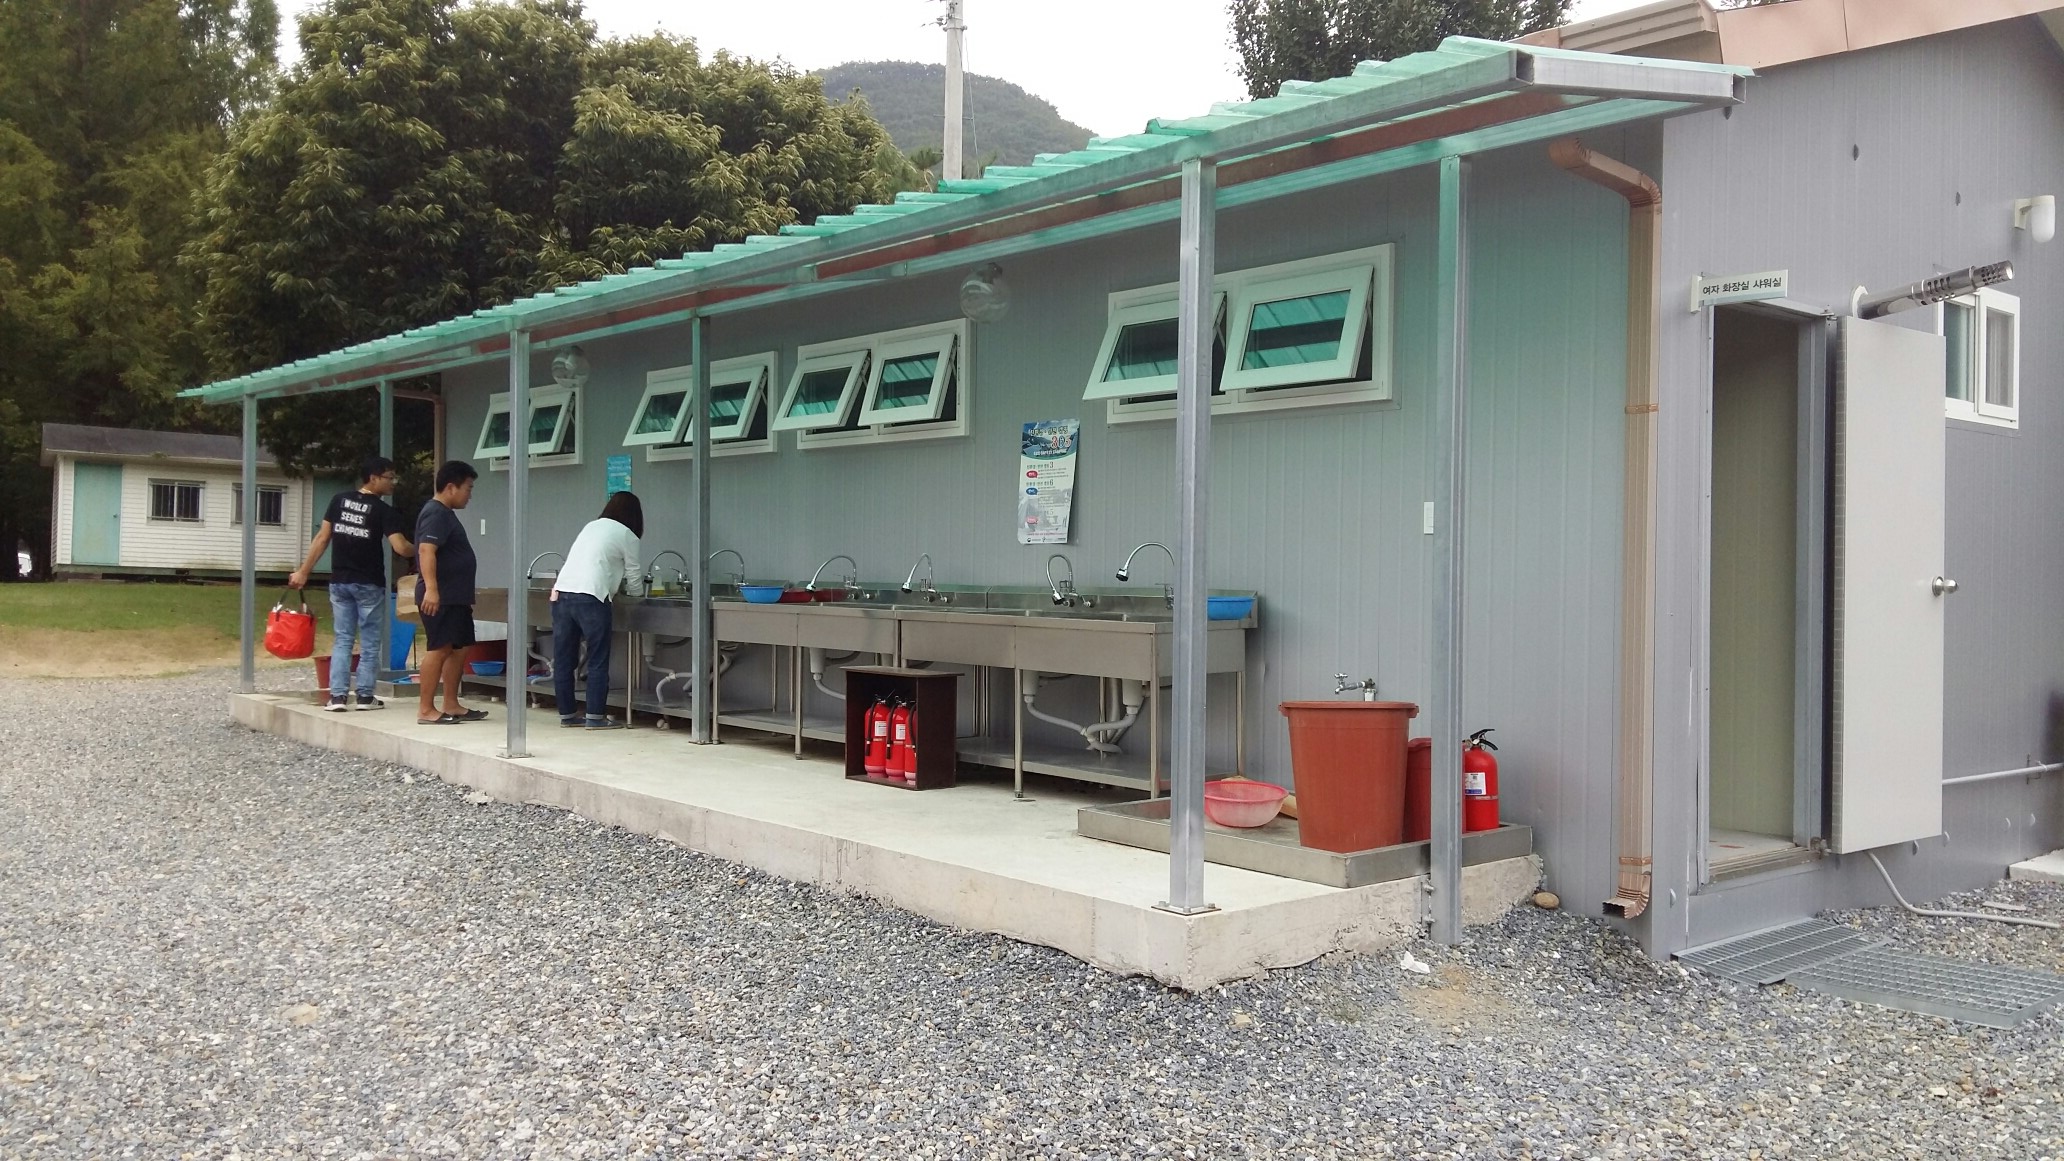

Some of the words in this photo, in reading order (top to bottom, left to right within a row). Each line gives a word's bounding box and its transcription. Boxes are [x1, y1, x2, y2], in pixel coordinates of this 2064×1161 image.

[1703, 285, 1719, 295] 여자
[1722, 281, 1750, 292] 화장실
[1753, 277, 1782, 289] 샤워실
[344, 499, 368, 513] WORLD
[341, 511, 364, 524] SERIES
[334, 523, 369, 538] CHAMPIONS
